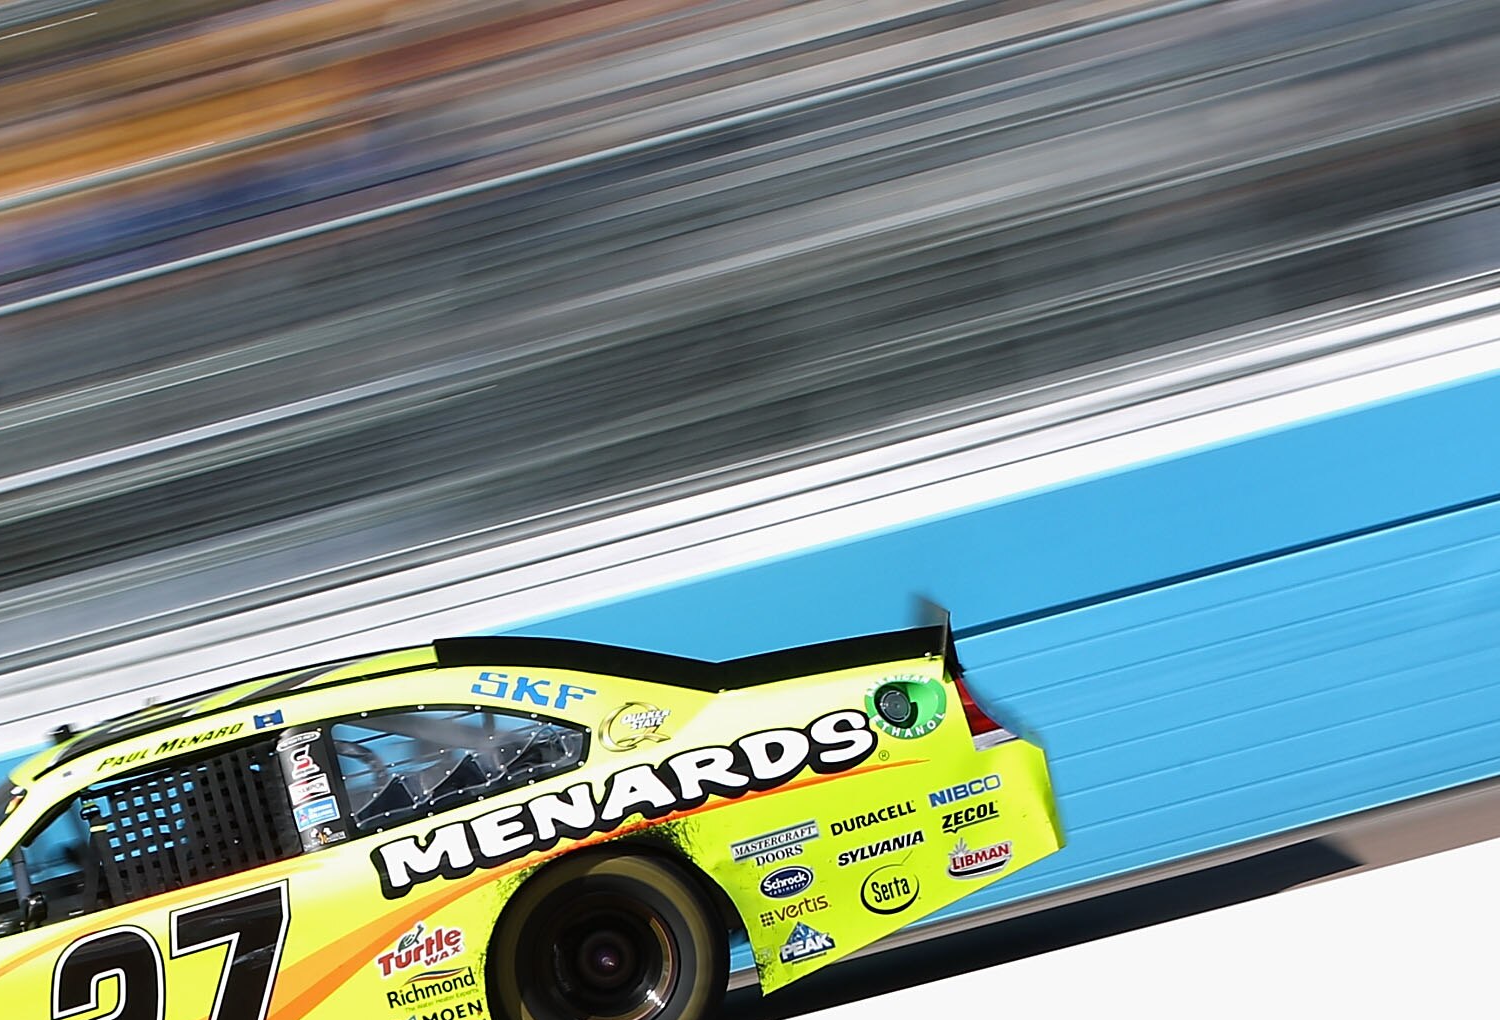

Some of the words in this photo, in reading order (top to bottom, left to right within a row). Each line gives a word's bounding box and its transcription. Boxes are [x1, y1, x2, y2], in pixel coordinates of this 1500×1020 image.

[471, 672, 597, 709] SKF
[620, 709, 671, 725] QUAKER
[630, 716, 664, 730] STATE
[870, 713, 946, 738] ETHANOL
[97, 748, 150, 772] PAUL
[154, 722, 245, 756] MENARD
[370, 709, 878, 899] MENARDS
[928, 775, 1001, 807] NIBCO
[830, 801, 916, 836] DURACELL
[942, 801, 998, 829] ZECOL
[734, 825, 815, 857] MASTERCRAFT
[838, 830, 924, 867] SYLVANIA
[756, 845, 803, 866] DOORS
[952, 844, 1010, 870] LIBMAN
[763, 872, 807, 892] Schrock
[871, 877, 911, 903] Serta
[774, 895, 829, 921] vertis
[378, 929, 461, 976] Turtle
[424, 945, 461, 966] WAX
[781, 933, 833, 960] PEAK
[387, 966, 475, 1009] Richmond
